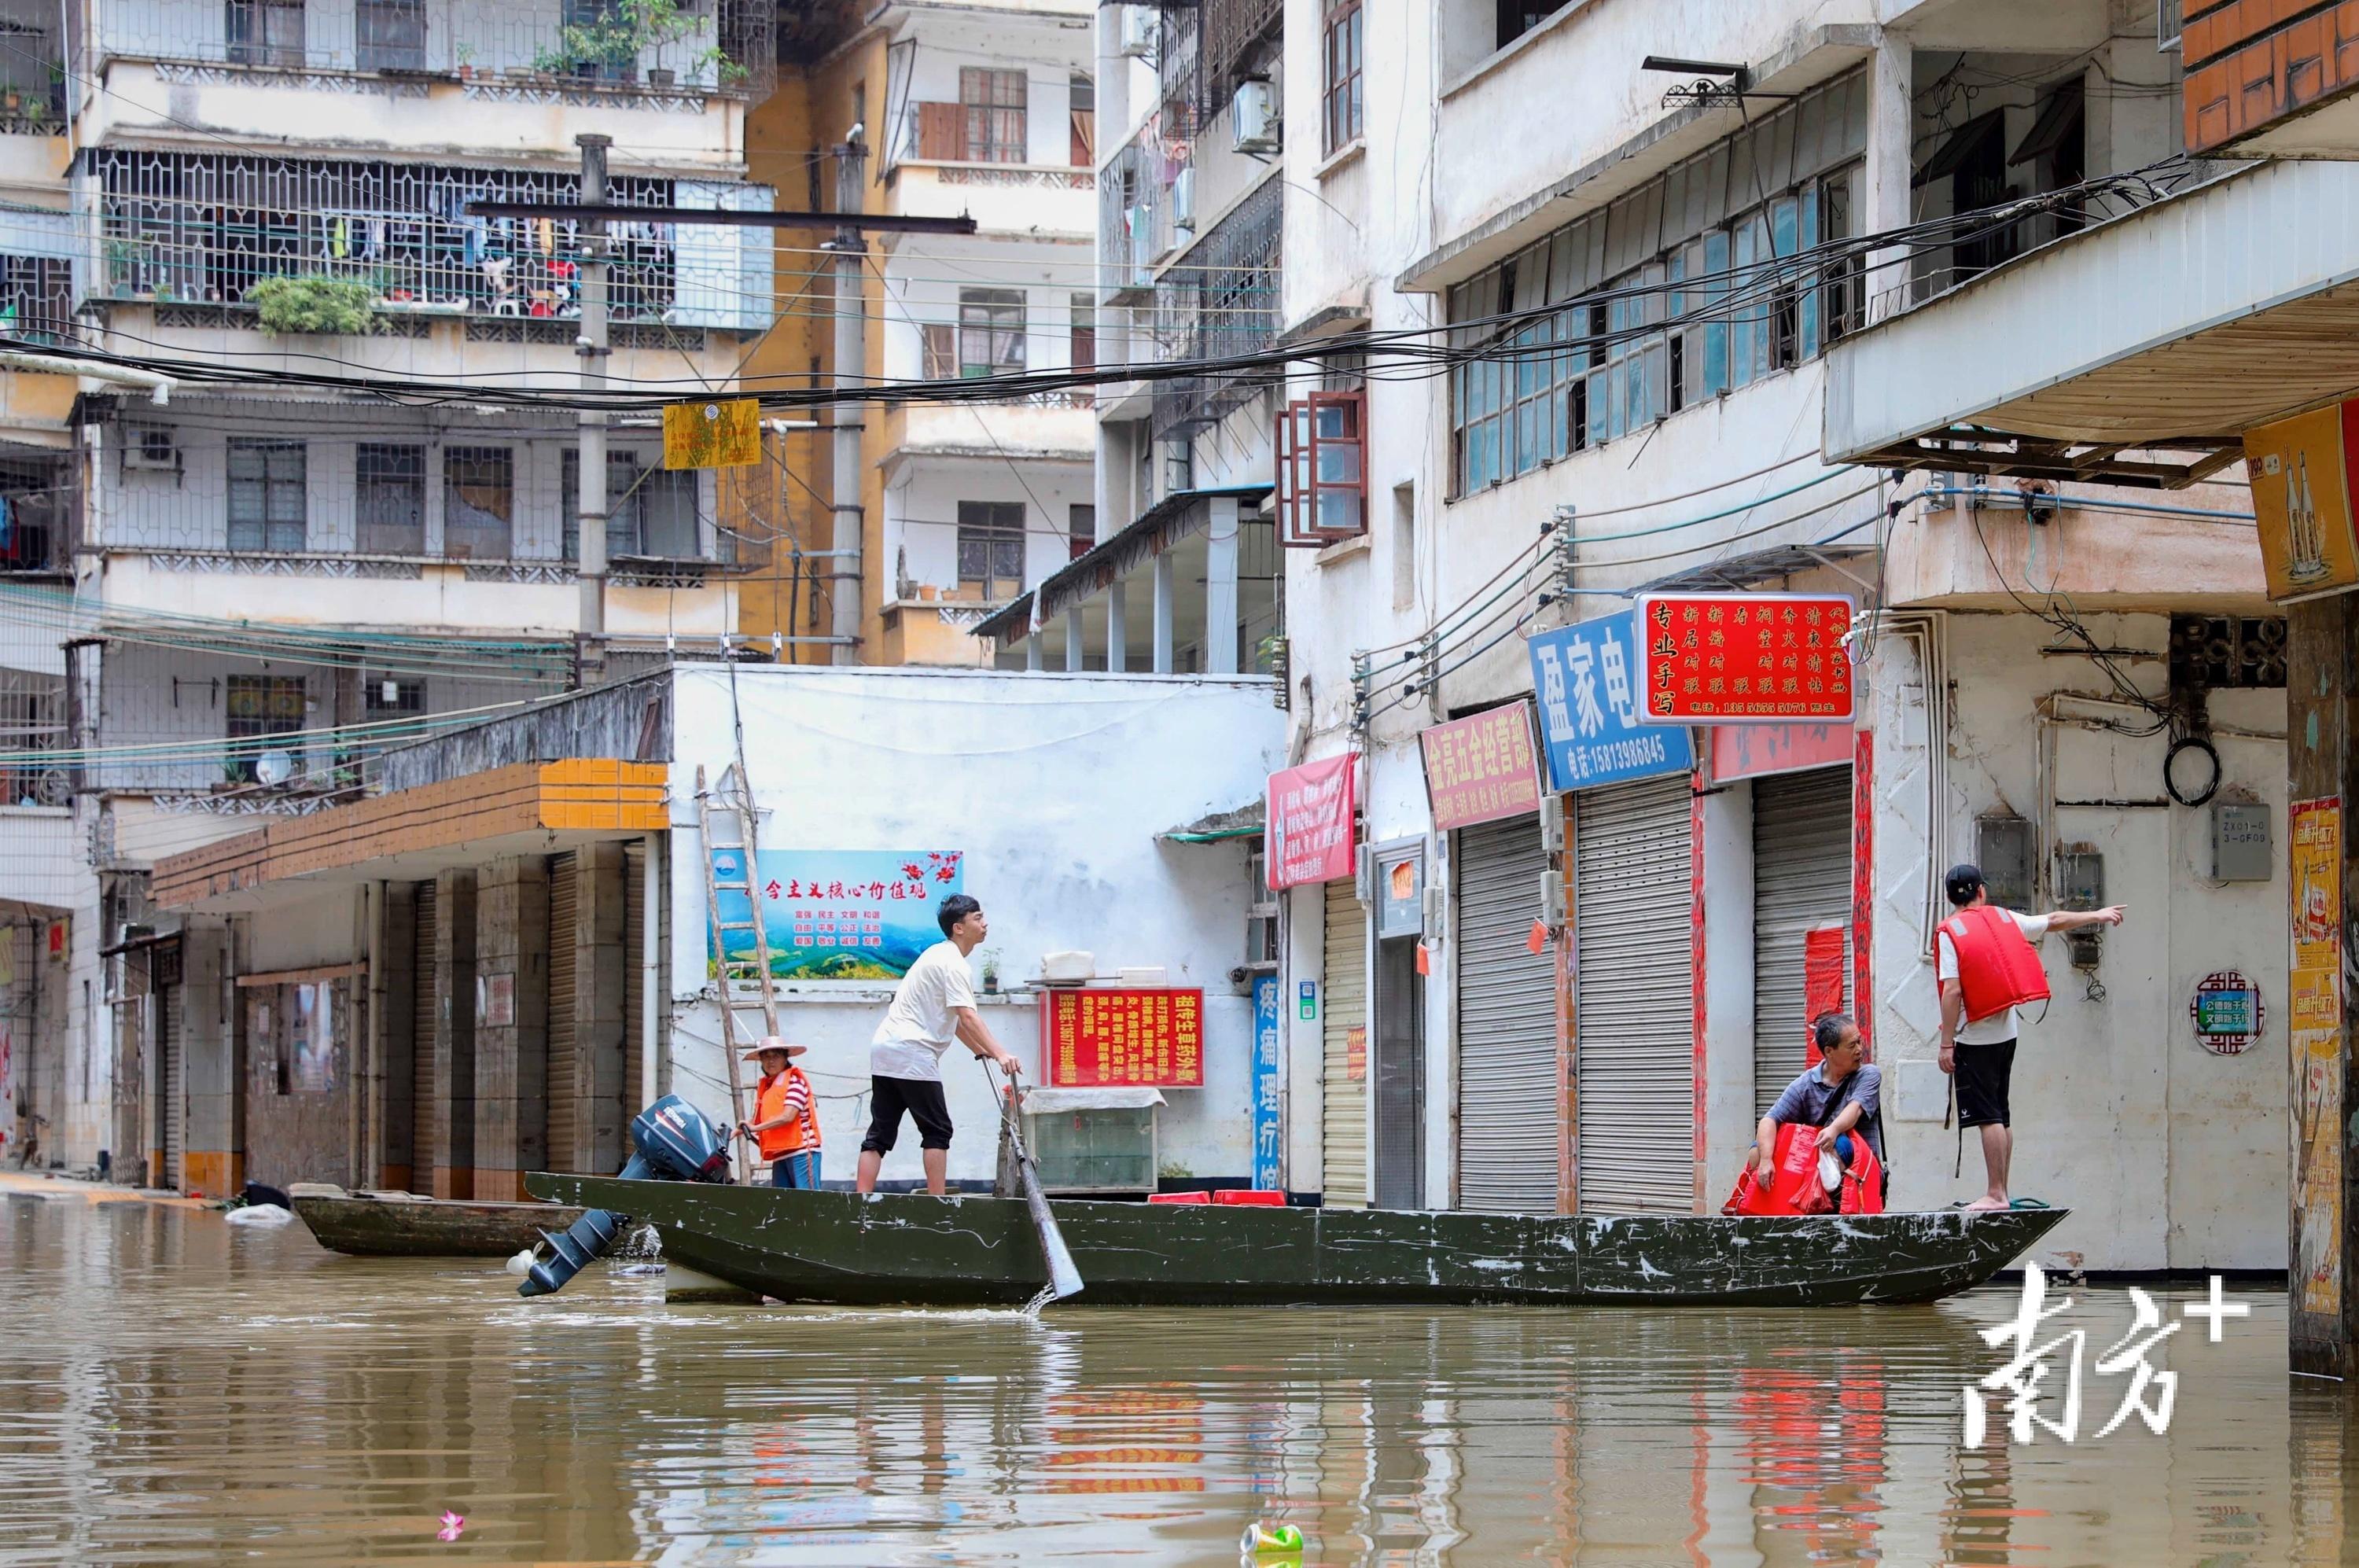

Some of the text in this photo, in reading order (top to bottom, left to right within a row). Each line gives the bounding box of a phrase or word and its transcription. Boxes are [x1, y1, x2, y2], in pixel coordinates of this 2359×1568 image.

[1537, 622, 1637, 743] 盈家电
[1651, 602, 1678, 714] 专业手写
[1683, 605, 1702, 694] 新居对联
[1708, 605, 1727, 694] 新婚对联
[1756, 605, 1776, 694] 祠堂对联
[1781, 605, 1800, 694] 香火对联
[1430, 710, 1529, 791] 金亮五金经营部
[795, 911, 881, 919] 富强 民主 文明 和谐
[795, 924, 881, 933] 自由 平等 公正 法治
[795, 937, 881, 946] 爱国 敬业 诚信 友善
[1175, 996, 1197, 1082] 祖传生草药外敷
[1259, 981, 1278, 1191] 疼痛理疗馆
